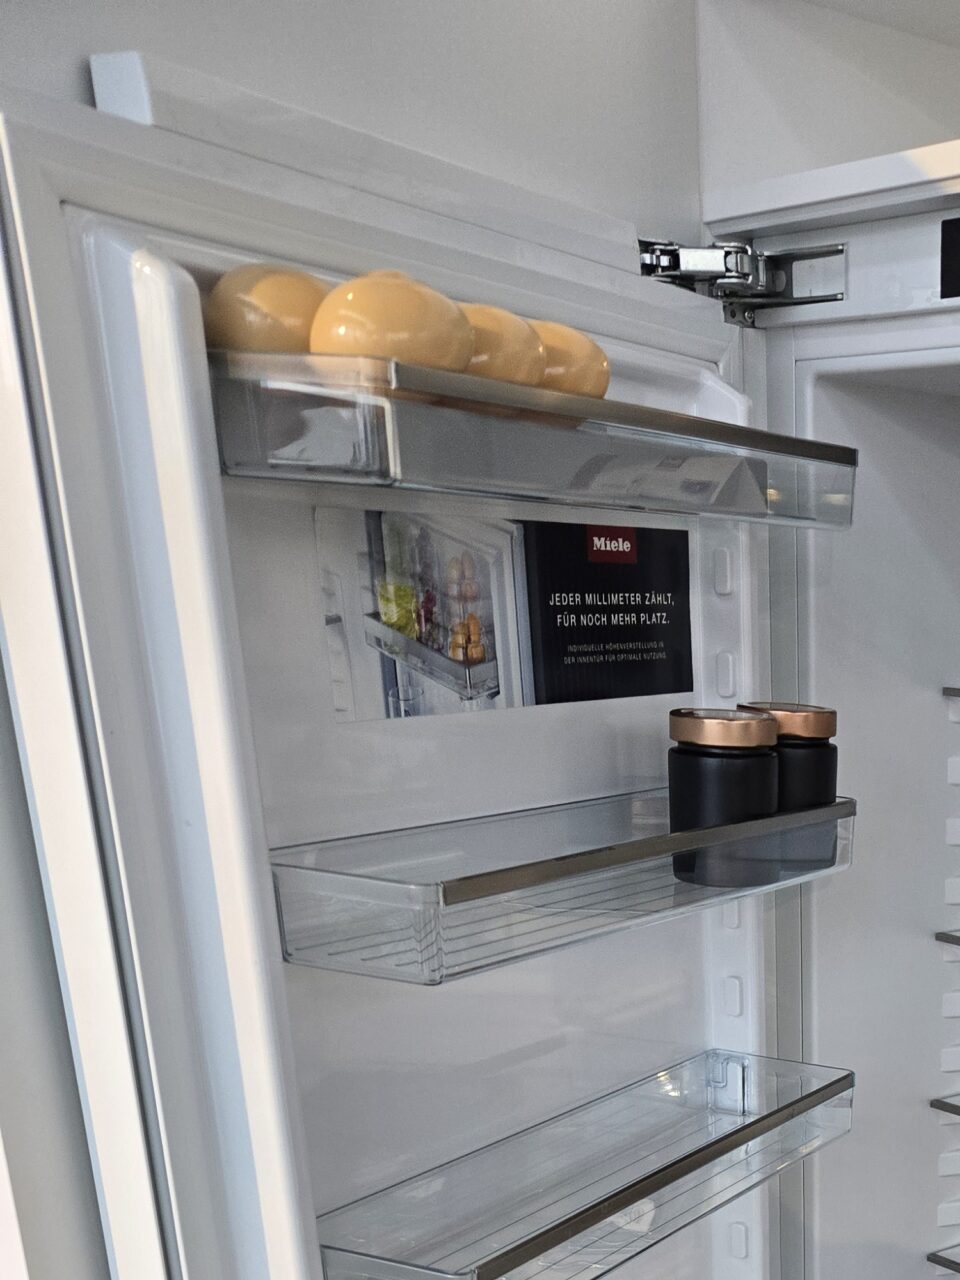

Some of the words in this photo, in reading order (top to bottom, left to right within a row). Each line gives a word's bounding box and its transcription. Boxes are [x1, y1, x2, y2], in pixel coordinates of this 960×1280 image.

[592, 536, 632, 552] Miele
[549, 593, 581, 606] JEDER
[585, 593, 642, 605] MILLIMETER
[645, 591, 675, 606] ZÄHLT,
[557, 611, 577, 627] FÜR
[580, 613, 608, 626] NOCH
[611, 613, 637, 625] MEHR
[640, 612, 670, 625] PLATZ.
